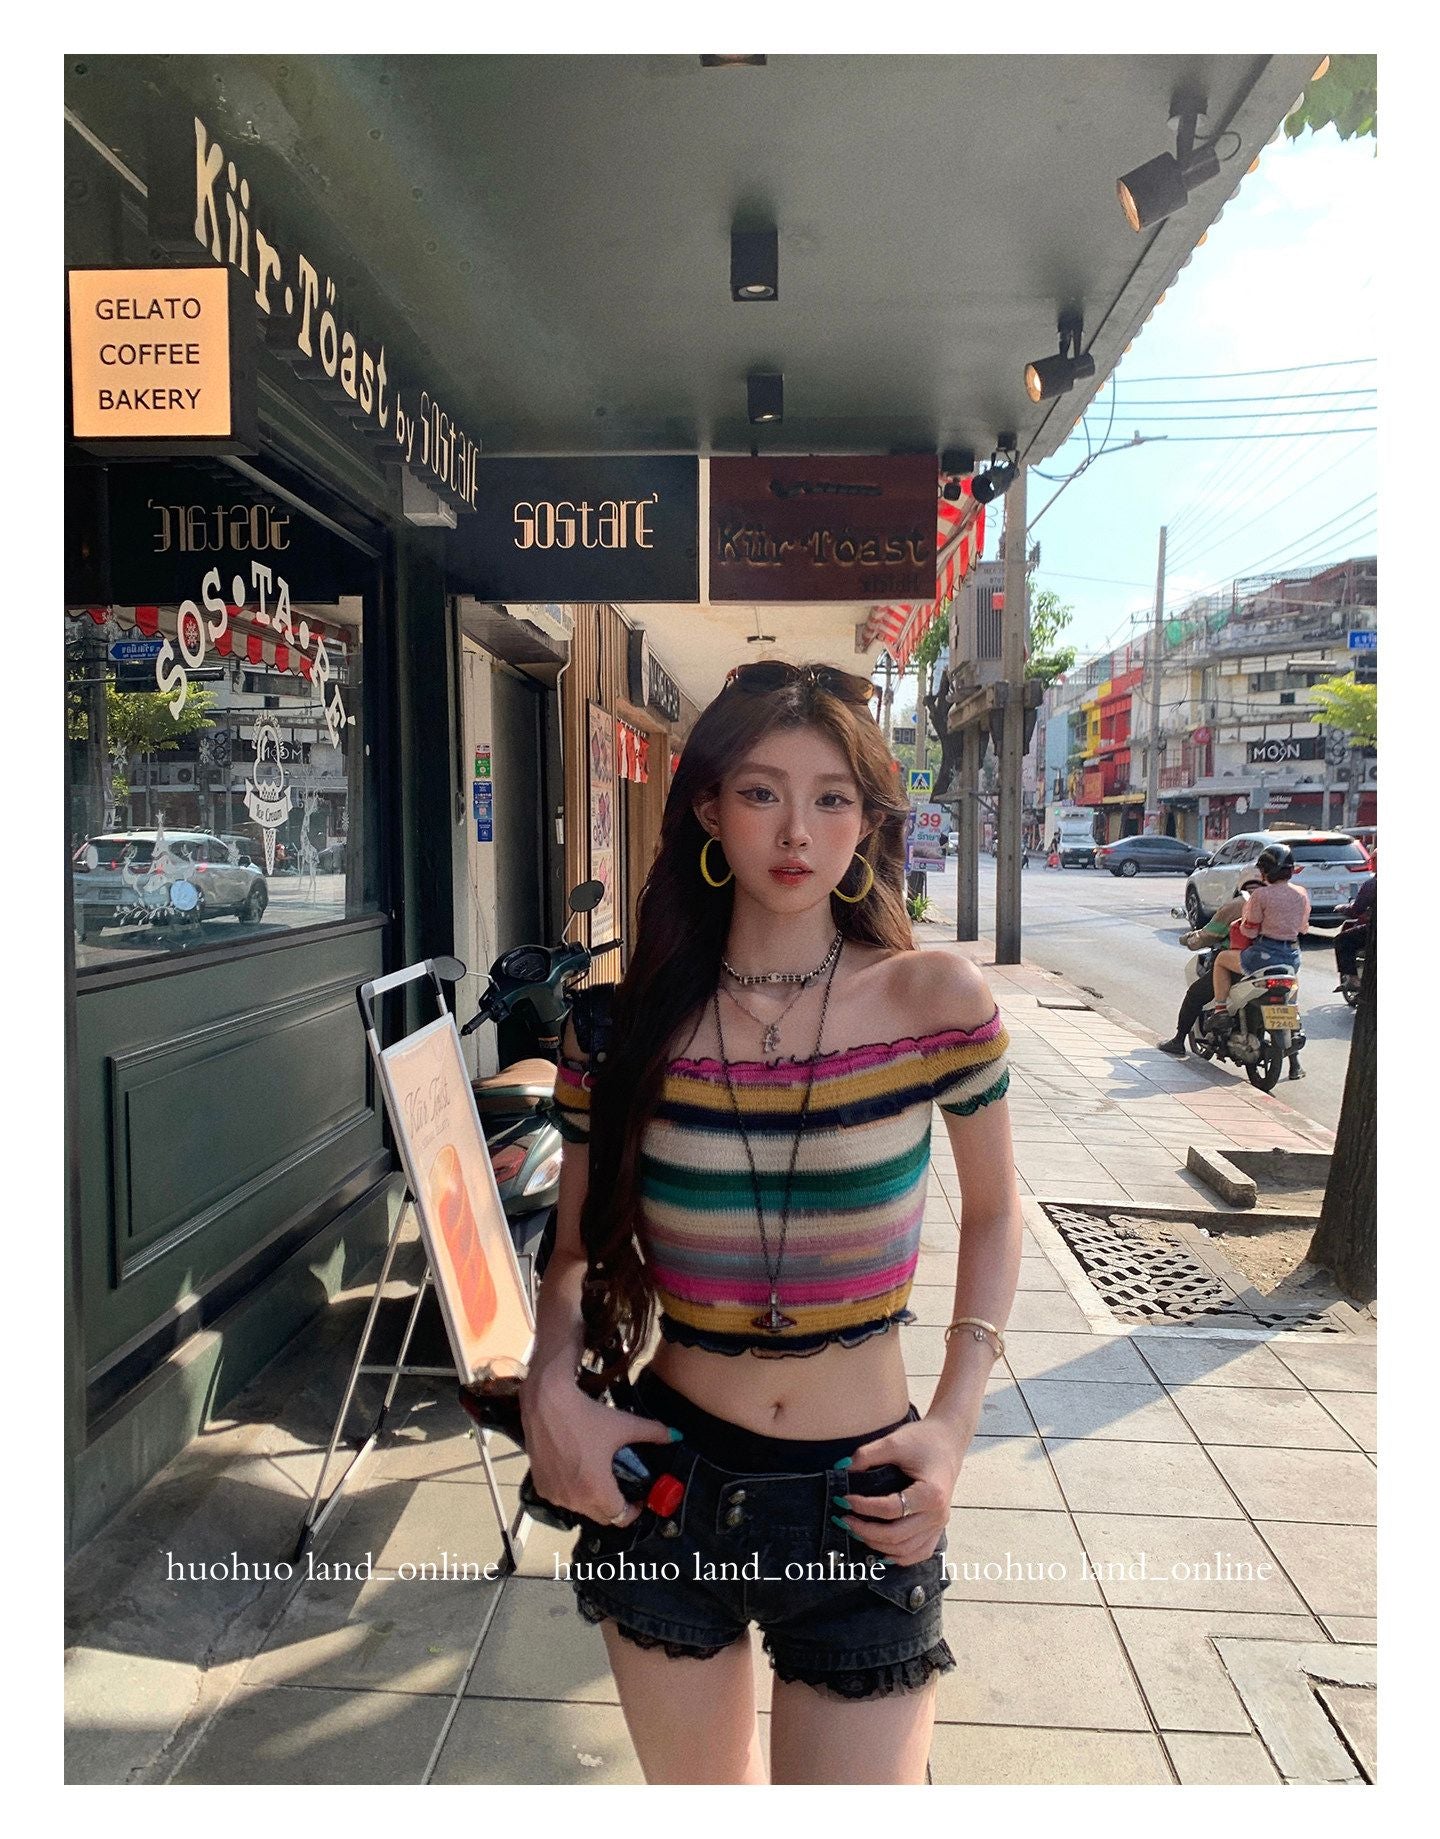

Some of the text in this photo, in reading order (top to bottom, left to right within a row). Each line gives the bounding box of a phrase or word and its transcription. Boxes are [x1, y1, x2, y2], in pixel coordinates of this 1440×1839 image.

[95, 298, 201, 321] GELATO
[99, 343, 200, 366] COFFEE
[98, 388, 201, 411] BAKERY
[396, 394, 415, 462] by
[918, 812, 942, 828] 39
